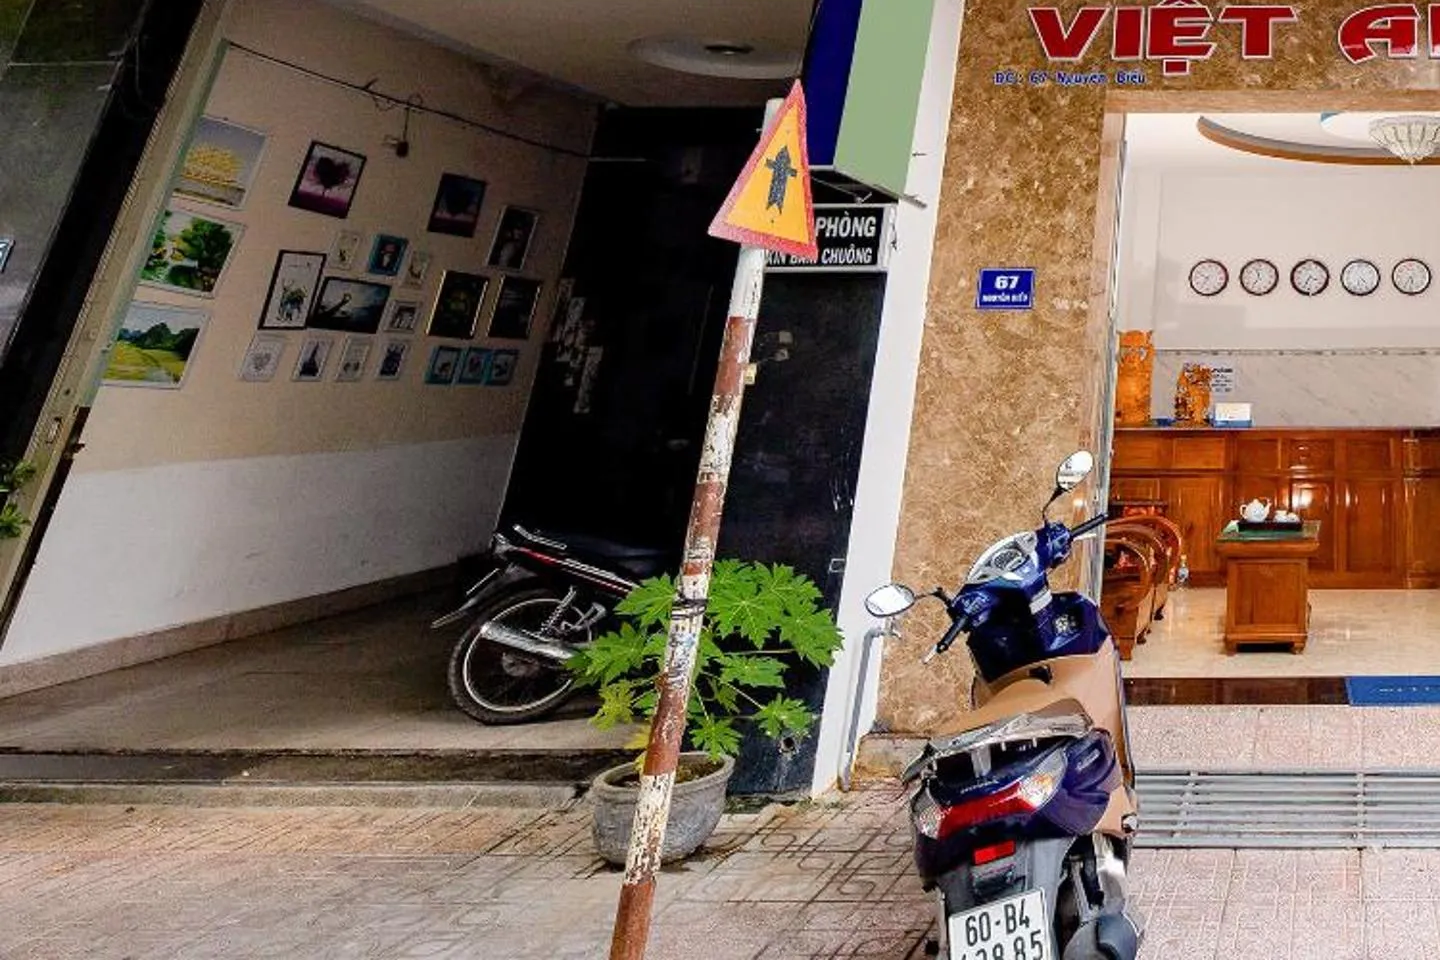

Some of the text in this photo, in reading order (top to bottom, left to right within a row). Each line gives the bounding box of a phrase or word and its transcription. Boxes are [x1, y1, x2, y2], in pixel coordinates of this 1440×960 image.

[815, 210, 877, 238] PHÒNG
[821, 243, 873, 265] CHUÔNG
[994, 275, 1020, 290] 67
[965, 898, 1030, 947] 60-B4
